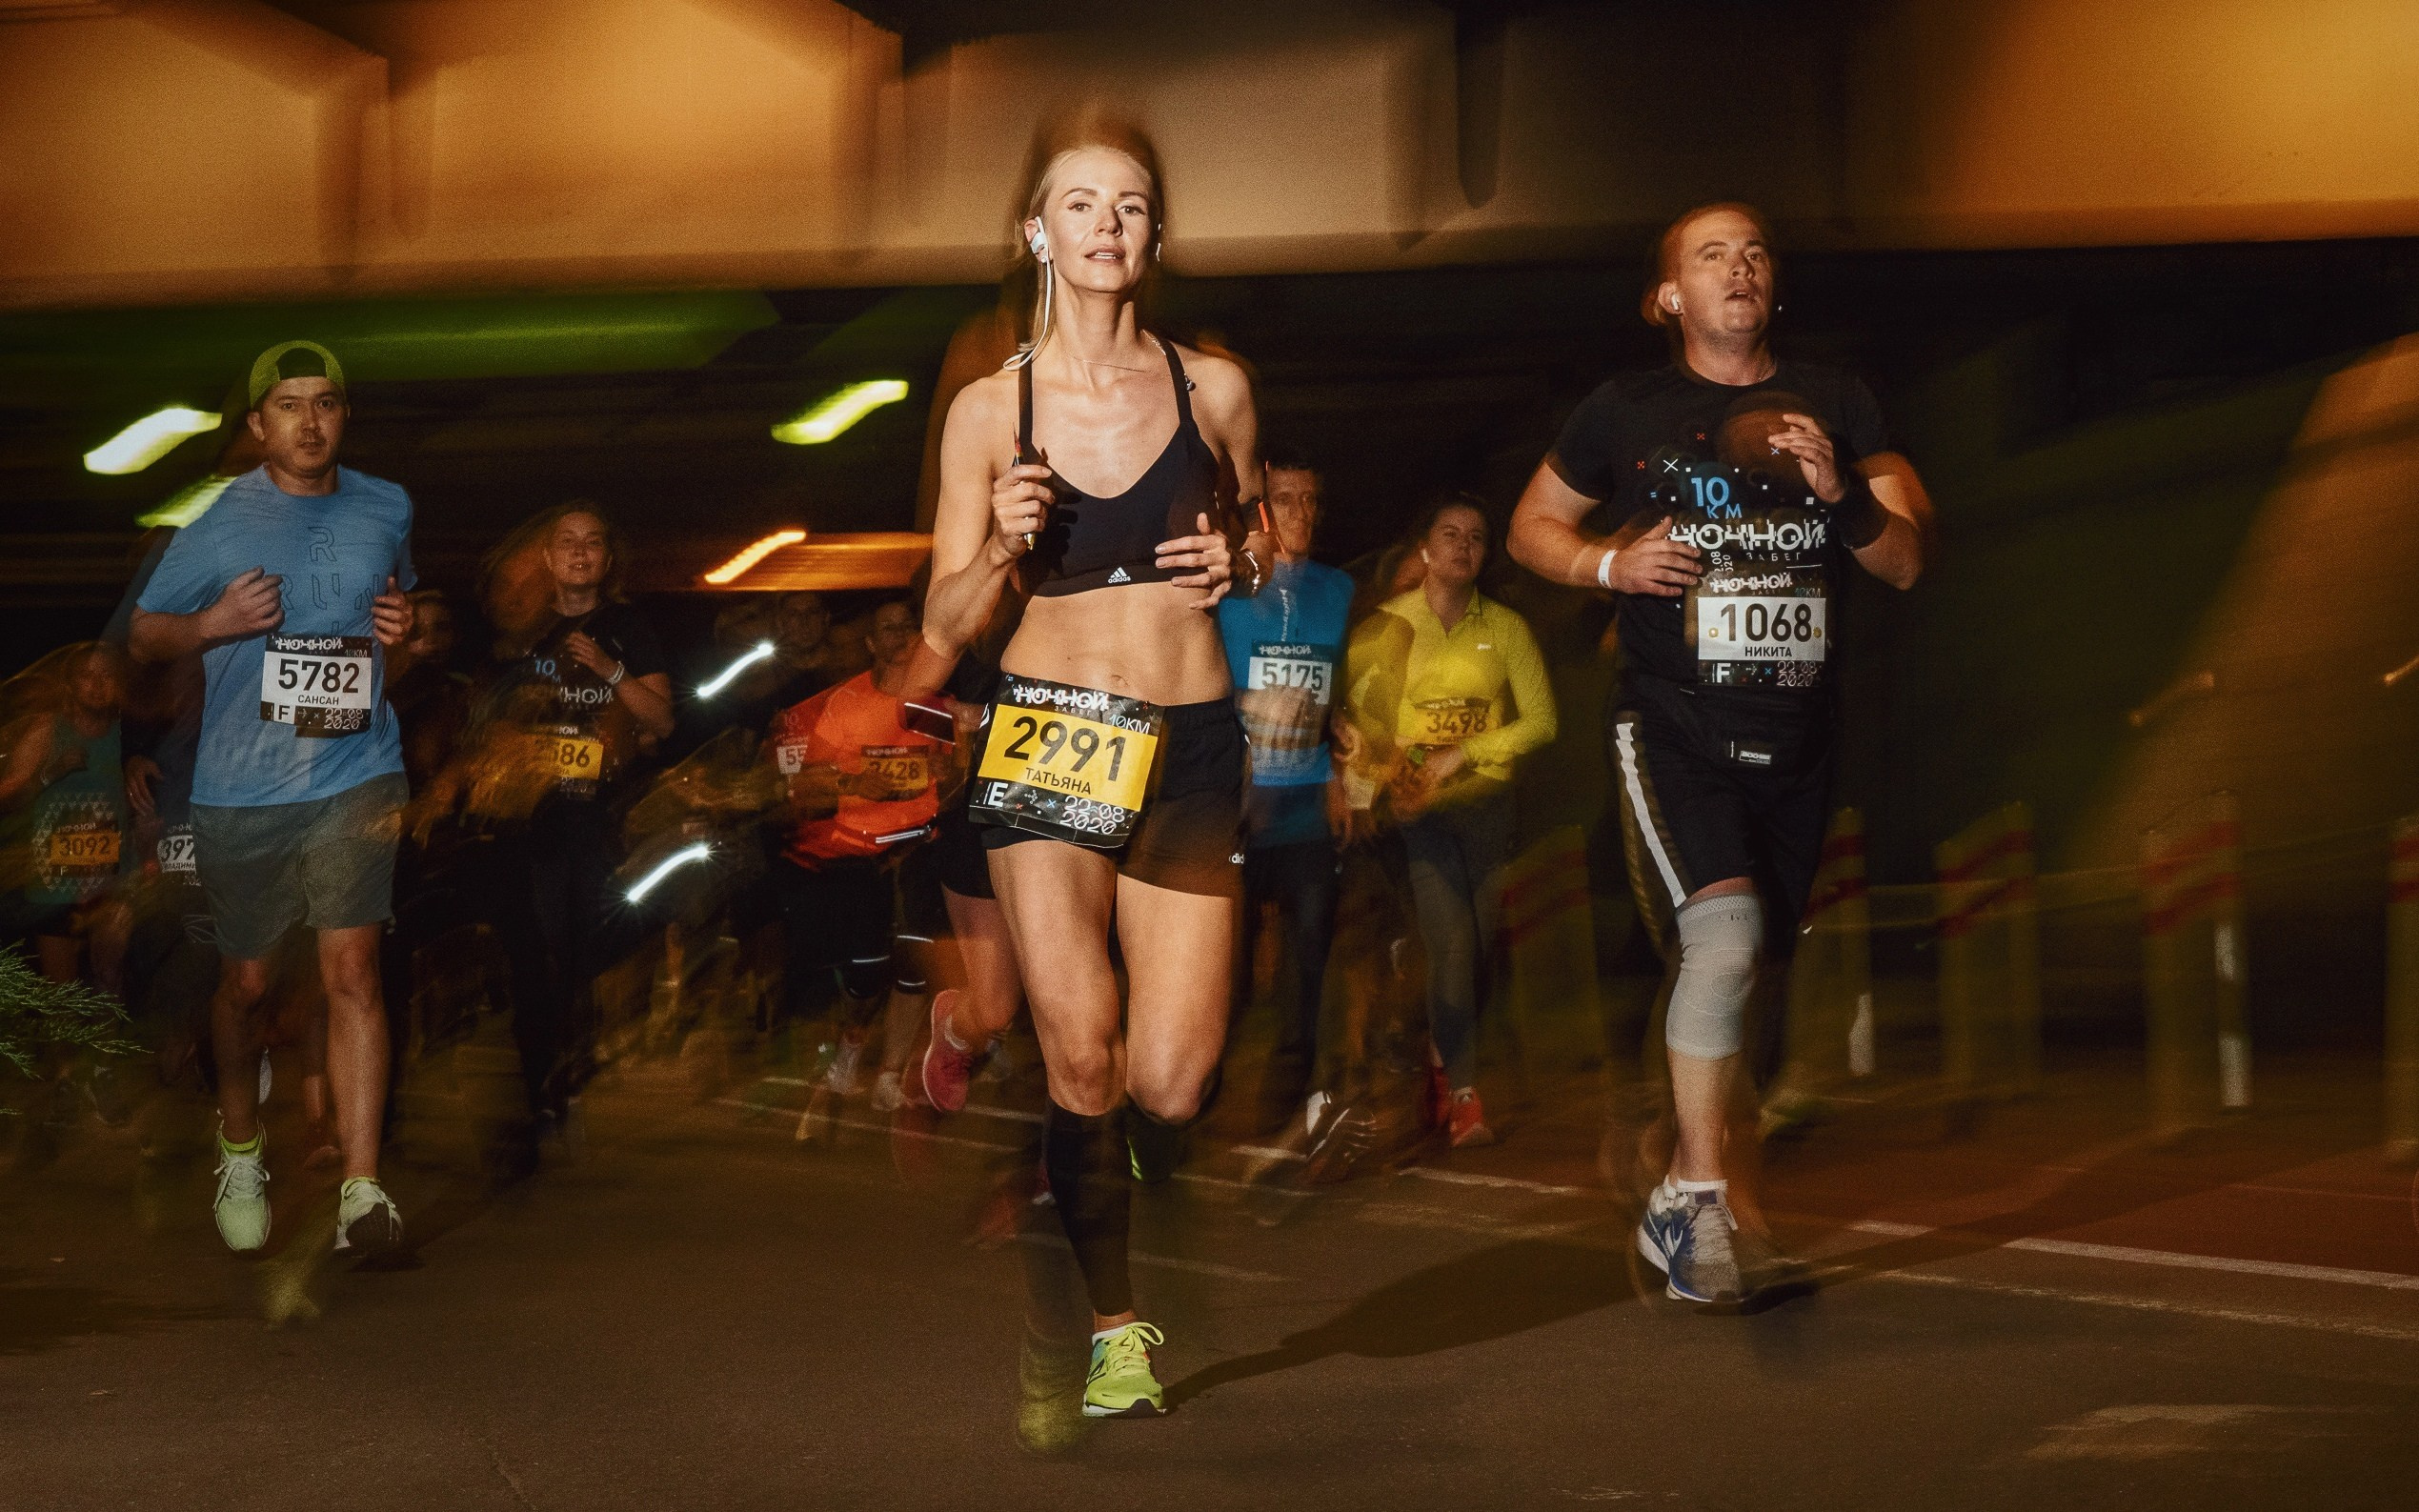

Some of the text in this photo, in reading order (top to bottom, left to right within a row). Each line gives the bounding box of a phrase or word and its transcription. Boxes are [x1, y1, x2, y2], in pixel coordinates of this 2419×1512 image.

[1691, 477, 1729, 507] 10
[1745, 552, 1801, 562] ЗАБЕГ
[1710, 573, 1793, 594] НОЧНОЙ
[1721, 603, 1812, 642] 1068
[275, 636, 344, 651] НОЧНОЙ
[1744, 646, 1793, 657] НИКИТА
[278, 658, 360, 694] 5782
[534, 659, 555, 675] 10
[1261, 662, 1323, 692] 5175
[1717, 663, 1732, 683] F
[297, 695, 340, 705] САНСАН
[1013, 684, 1109, 713] НОЧНОЙ
[278, 705, 291, 720] F
[1055, 706, 1092, 716] ЗАБЕГ
[324, 719, 360, 730] 2020
[1426, 711, 1487, 734] 3498
[1004, 716, 1127, 782] 2991
[1025, 768, 1091, 796] ТАТЬЯНА
[988, 782, 1009, 807] E
[1059, 811, 1117, 835] 2020
[59, 836, 111, 857] 3092
